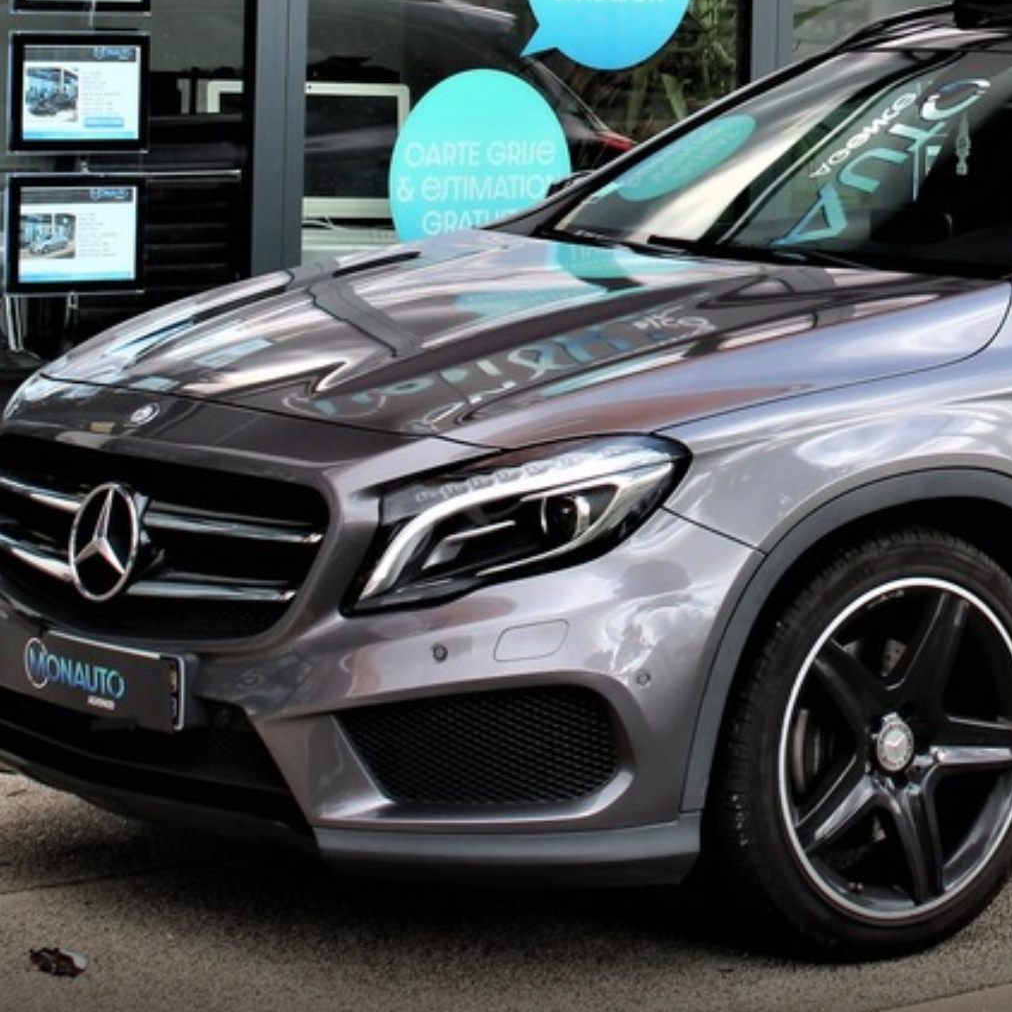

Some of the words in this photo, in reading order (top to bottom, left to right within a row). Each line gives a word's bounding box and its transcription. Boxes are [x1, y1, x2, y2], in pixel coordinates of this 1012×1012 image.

[404, 140, 481, 168] CARTE
[396, 176, 414, 202] &
[29, 647, 125, 699] MONAUTO
